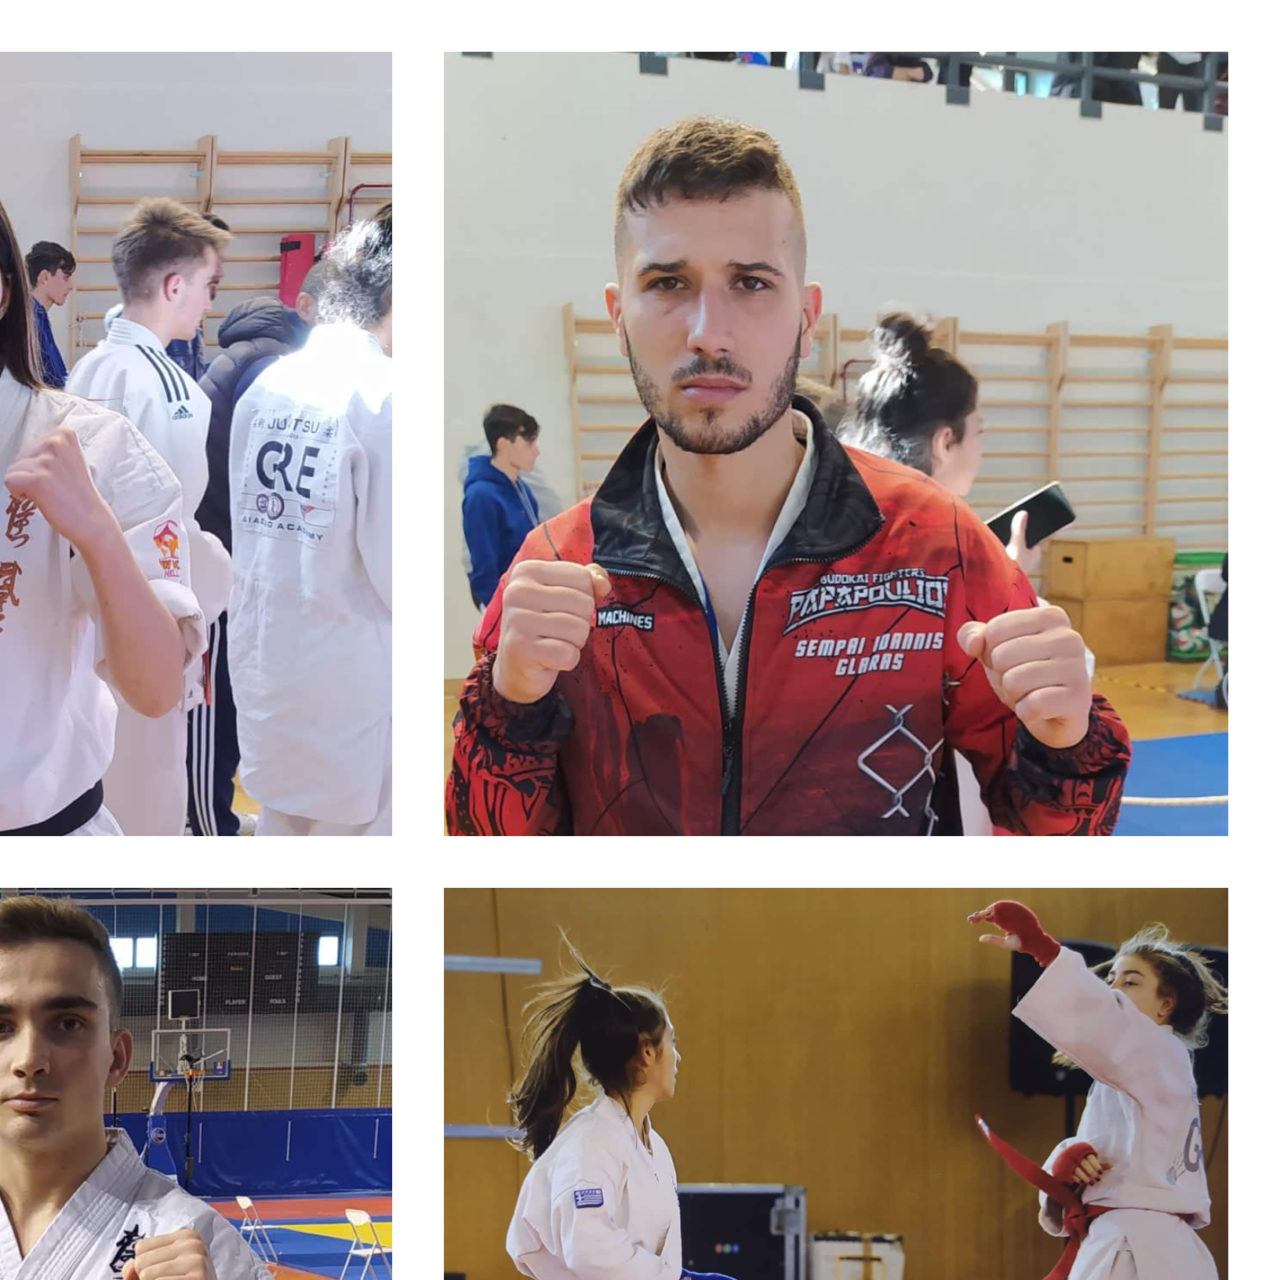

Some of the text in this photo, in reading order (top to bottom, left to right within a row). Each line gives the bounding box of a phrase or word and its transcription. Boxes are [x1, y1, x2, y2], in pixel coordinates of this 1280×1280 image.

[597, 609, 654, 630] MACHINES
[795, 632, 945, 657] SEMPAI IOANNIS
[835, 653, 905, 676] GLARAS
